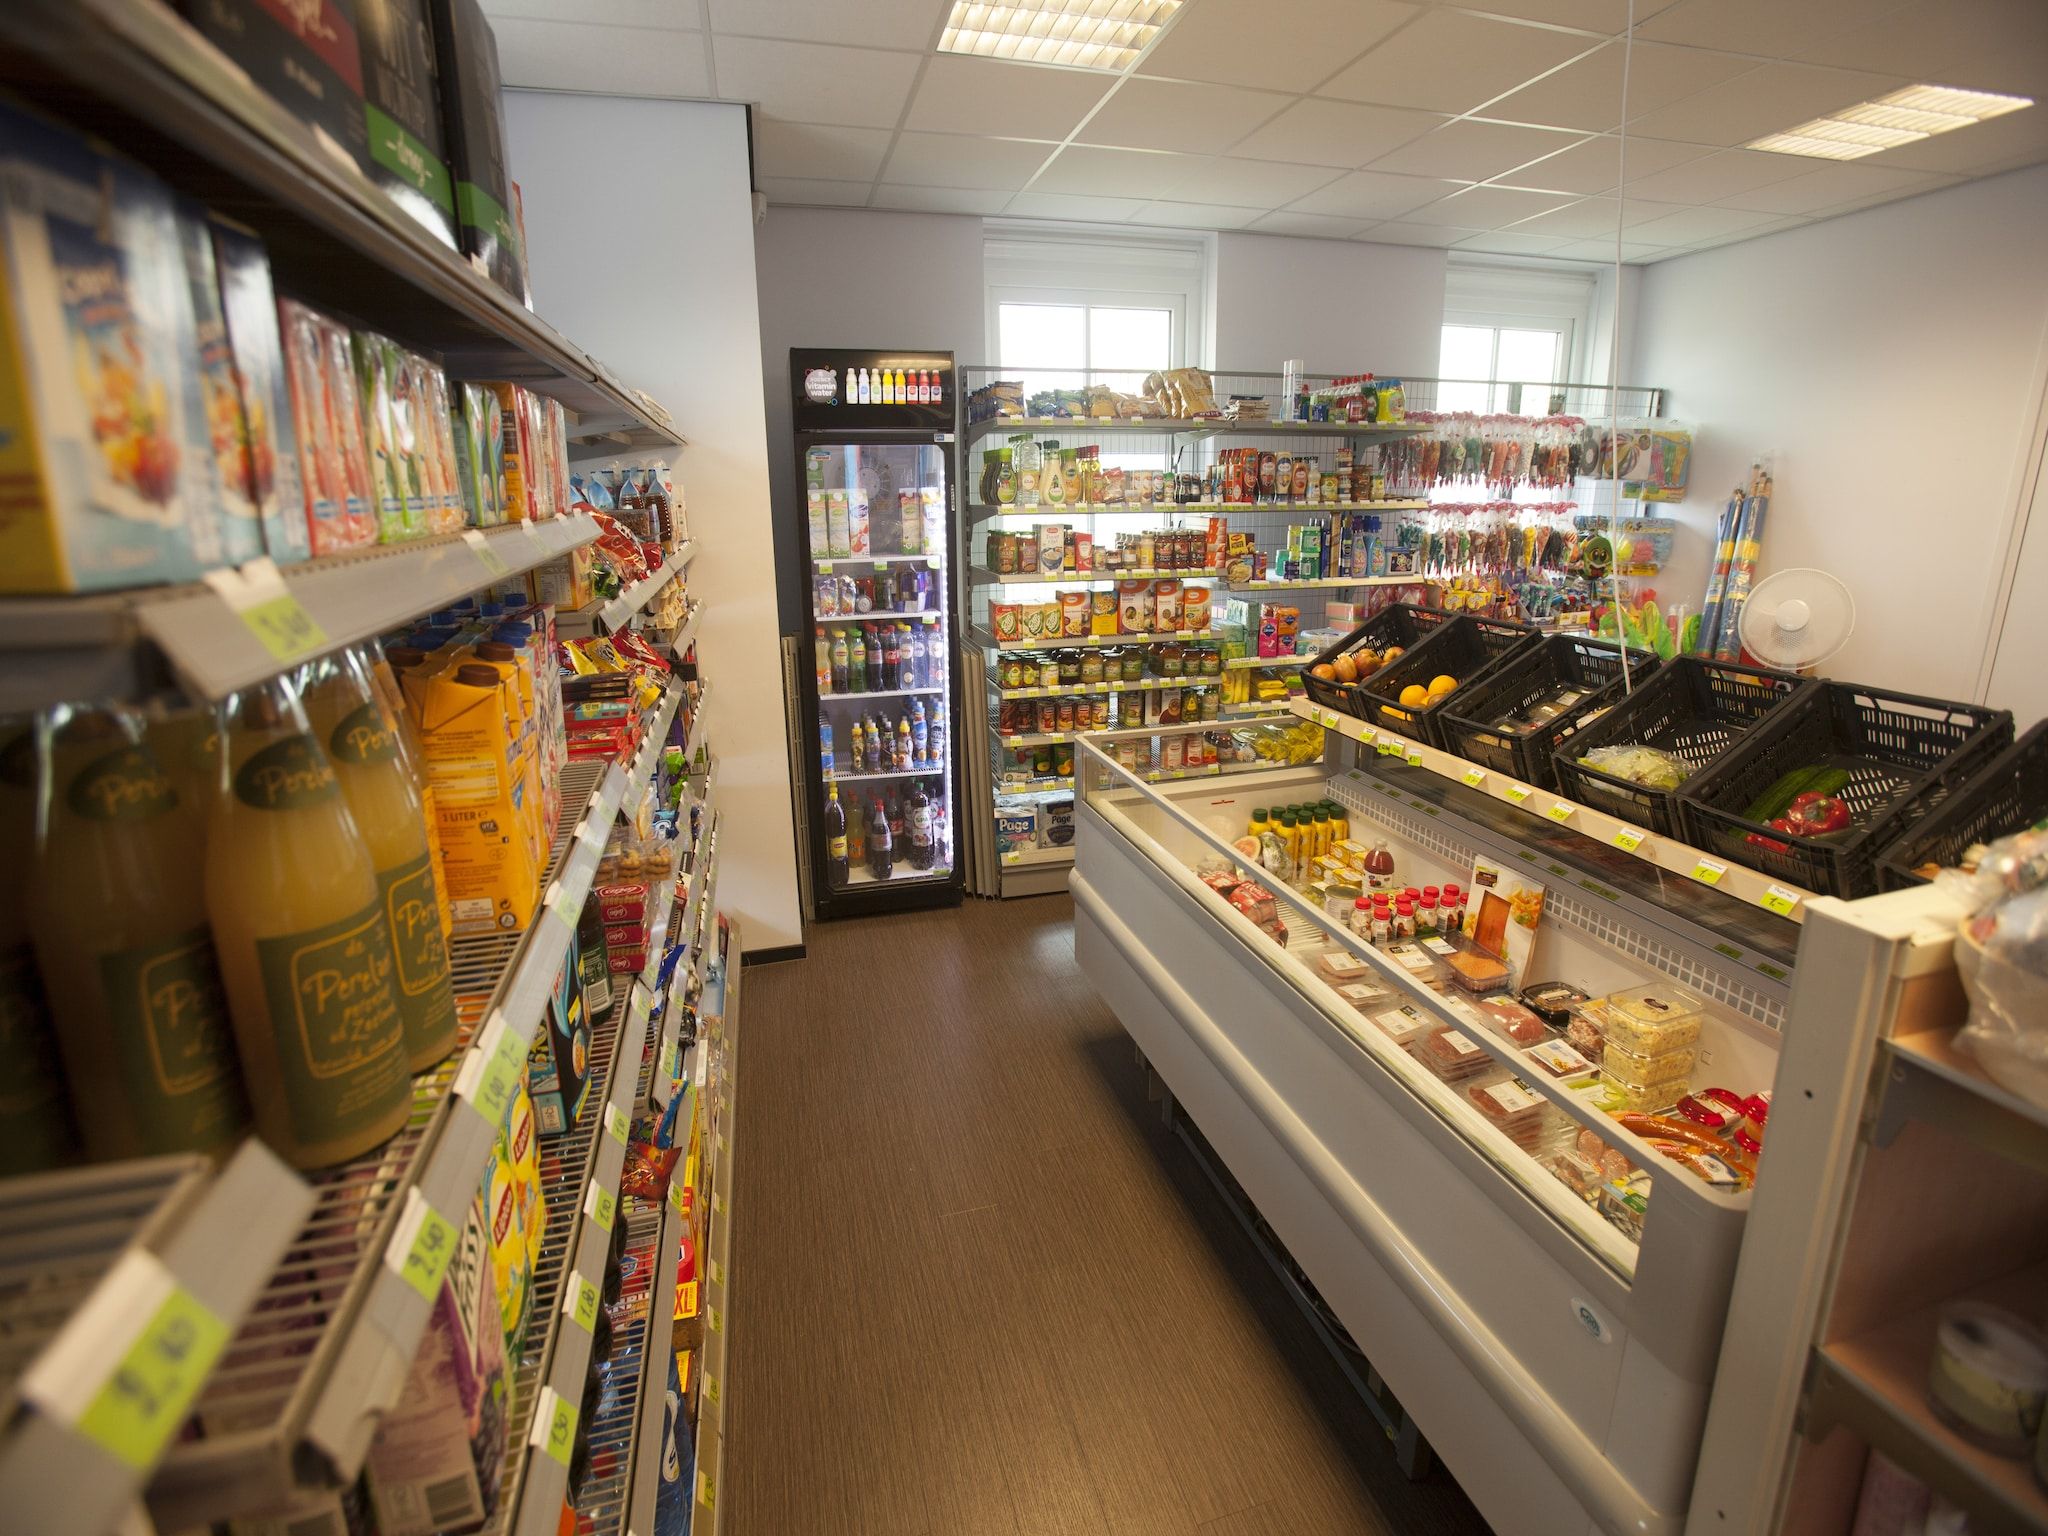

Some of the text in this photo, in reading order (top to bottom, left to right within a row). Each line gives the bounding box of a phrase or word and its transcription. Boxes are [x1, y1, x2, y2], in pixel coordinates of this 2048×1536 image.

[807, 382, 836, 390] vitamin
[449, 811, 477, 822] LITER
[1052, 815, 1071, 824] Page
[1000, 818, 1030, 833] Page
[674, 1288, 692, 1315] XL
